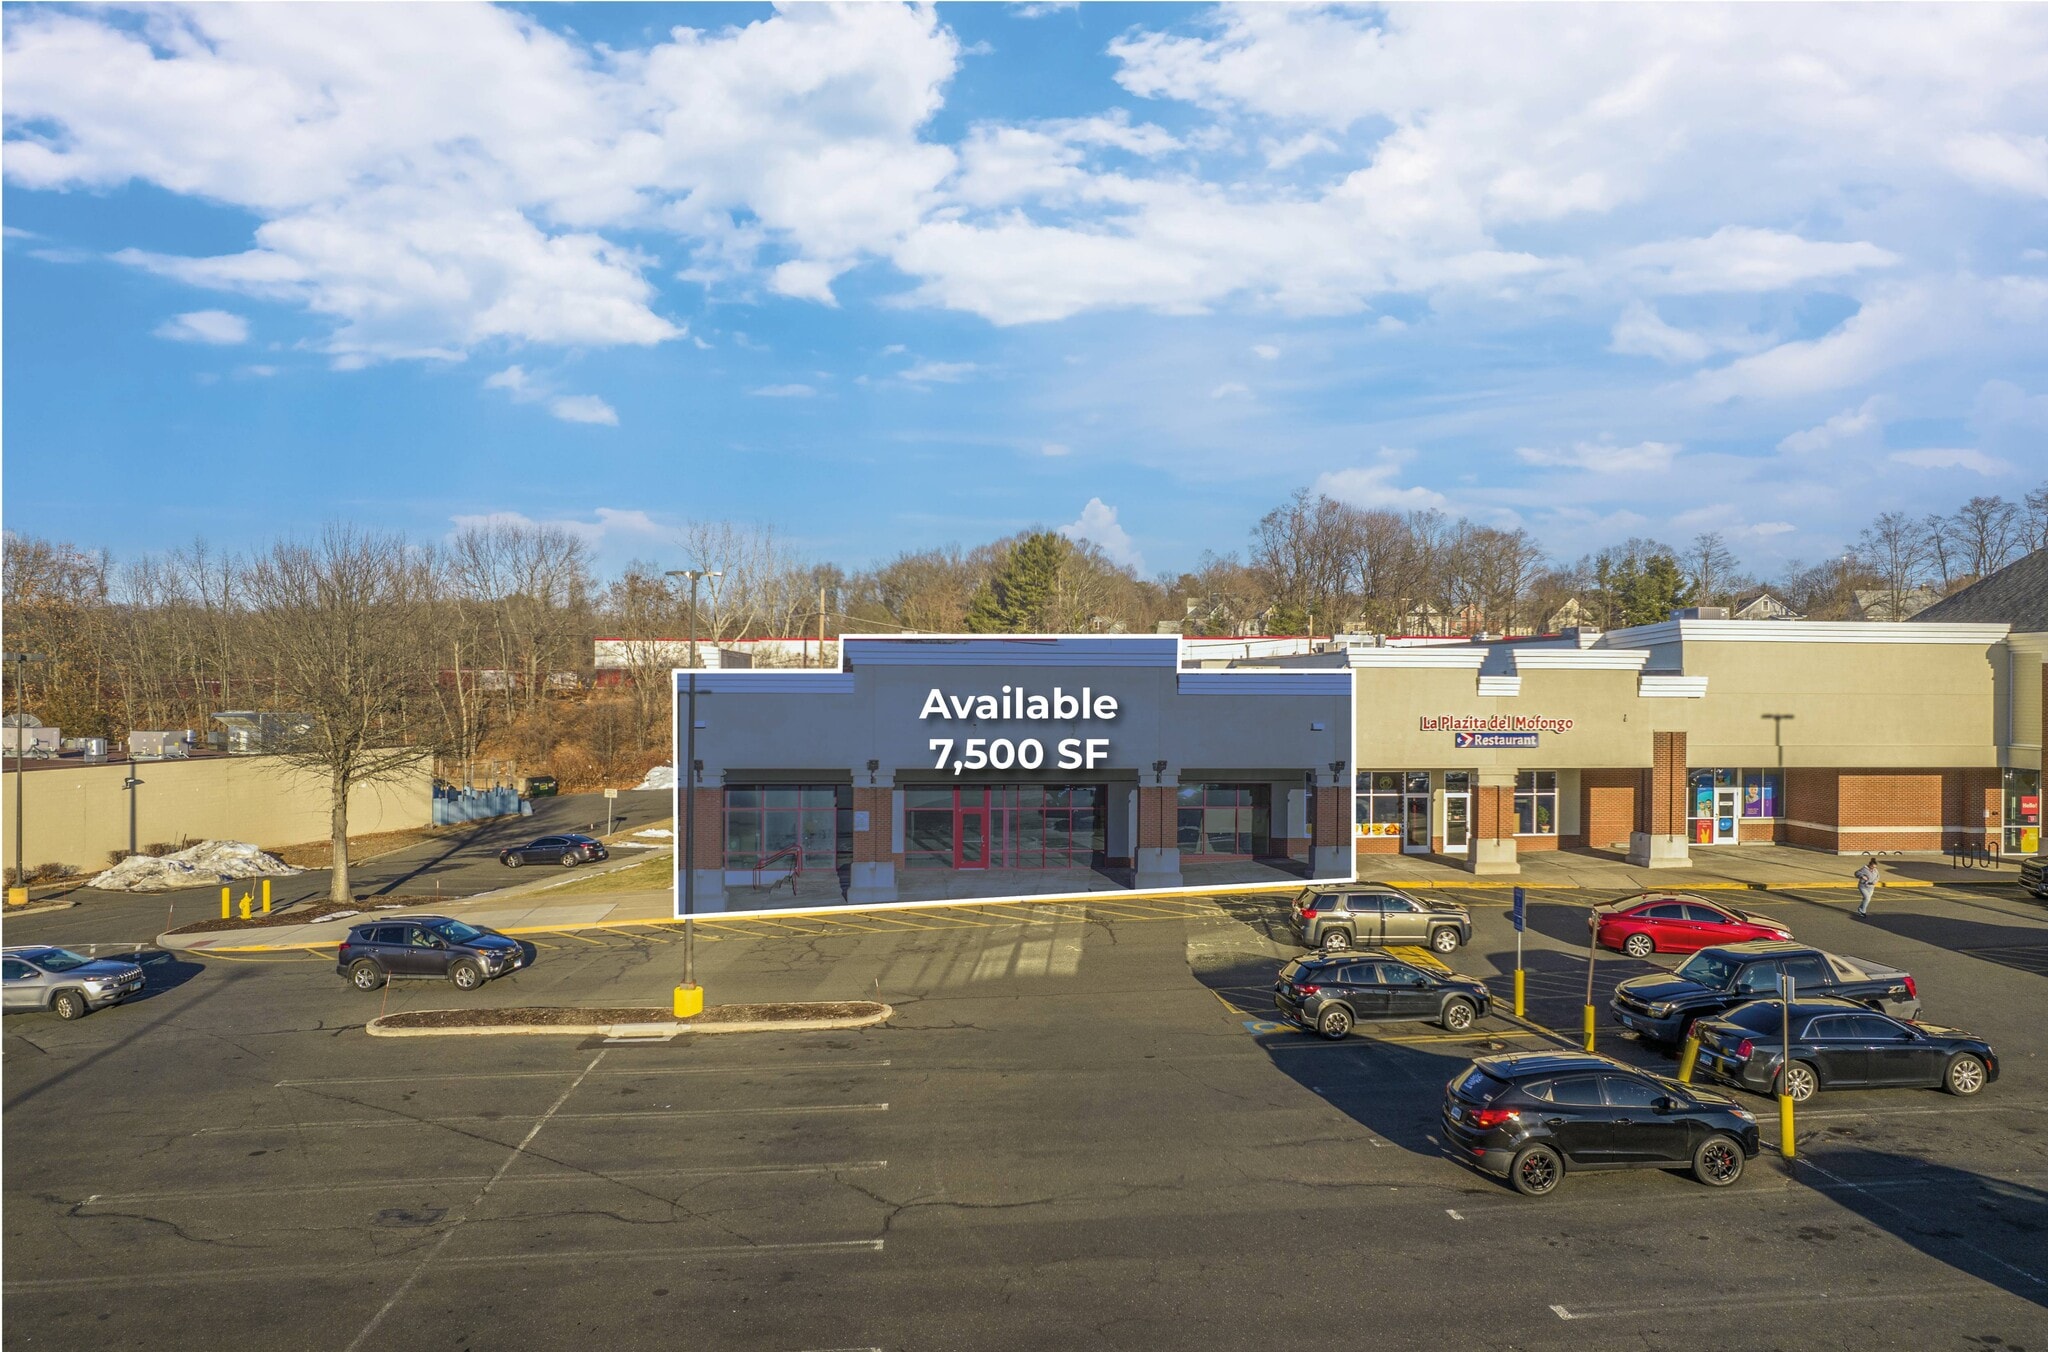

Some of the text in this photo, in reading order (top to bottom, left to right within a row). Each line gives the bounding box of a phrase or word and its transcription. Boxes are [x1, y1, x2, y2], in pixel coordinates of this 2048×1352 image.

[1422, 714, 1574, 733] La Plazita del Mofongo
[1474, 734, 1537, 746] Restaurant
